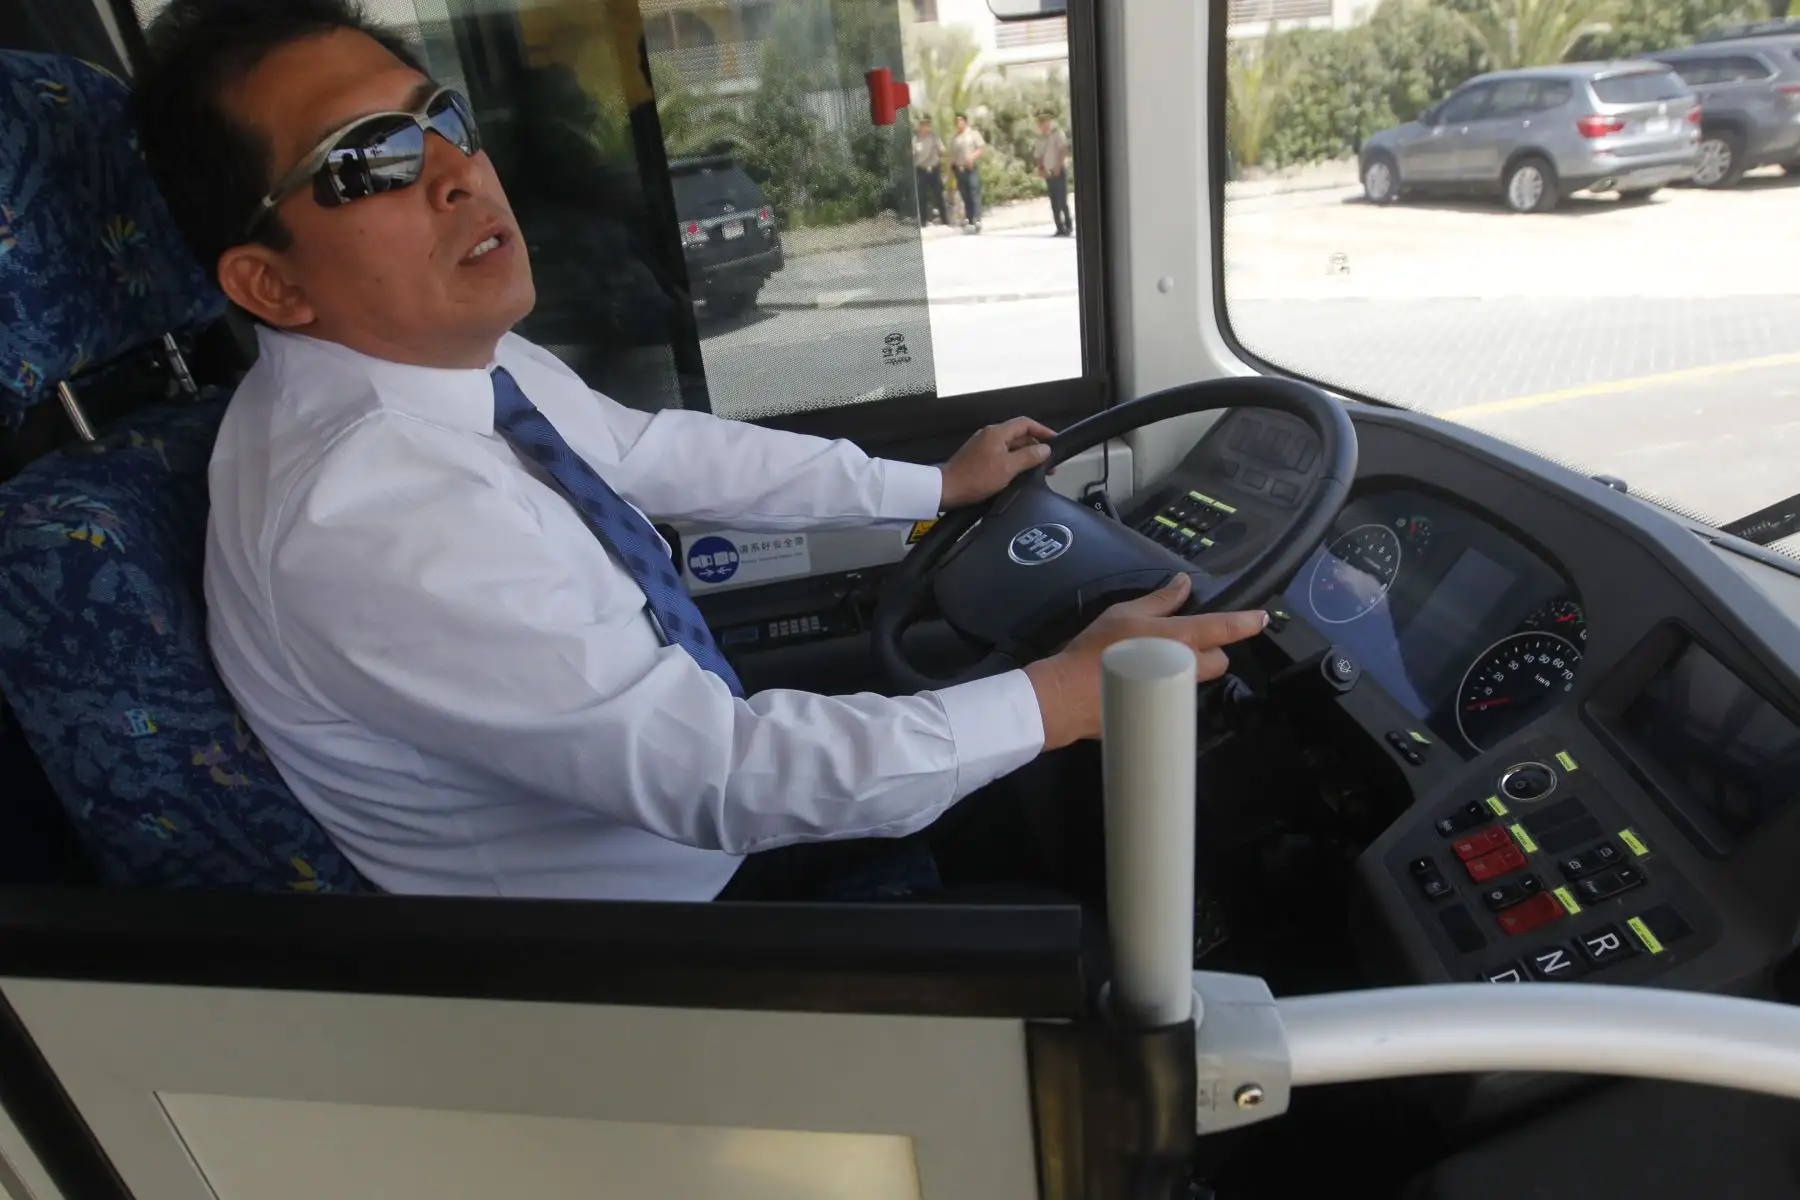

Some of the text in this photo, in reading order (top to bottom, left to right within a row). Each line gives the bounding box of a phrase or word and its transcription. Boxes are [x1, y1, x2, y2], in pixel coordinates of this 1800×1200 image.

[1552, 658, 1565, 669] 60
[1561, 669, 1574, 680] 70
[1587, 933, 1620, 957] R
[1536, 950, 1571, 973] N
